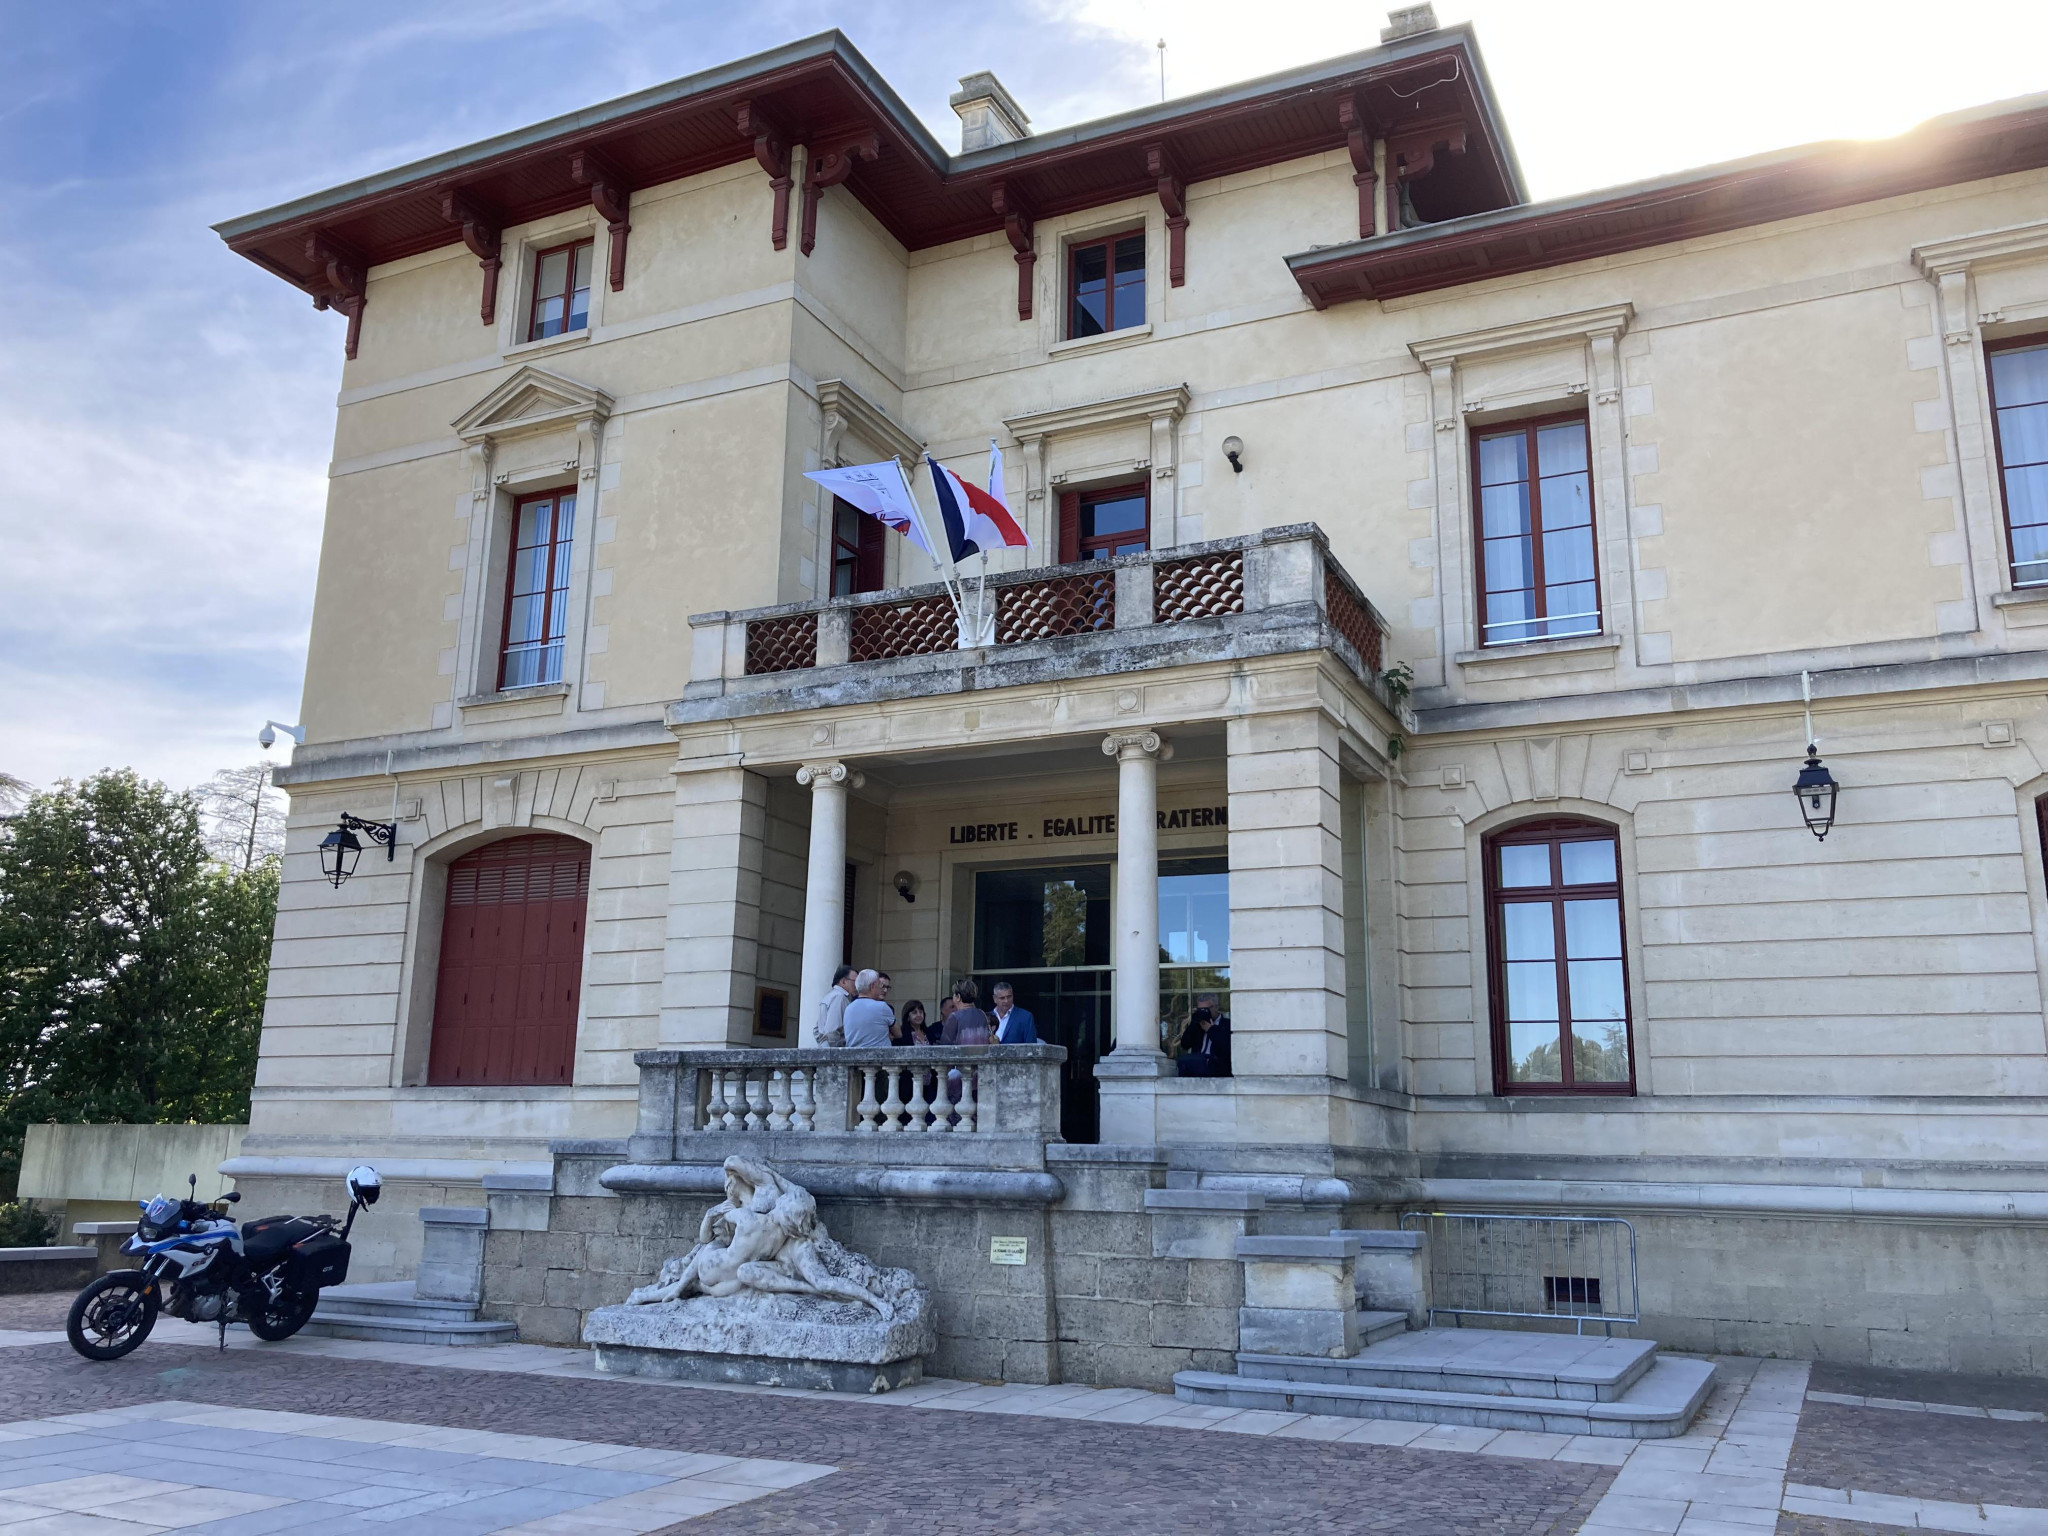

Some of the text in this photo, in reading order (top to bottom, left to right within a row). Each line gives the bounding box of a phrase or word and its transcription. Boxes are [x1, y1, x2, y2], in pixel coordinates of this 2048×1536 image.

[950, 822, 1018, 844] LIBERTE
[1043, 814, 1115, 837] EGALITE
[1157, 806, 1228, 829] RATERN
